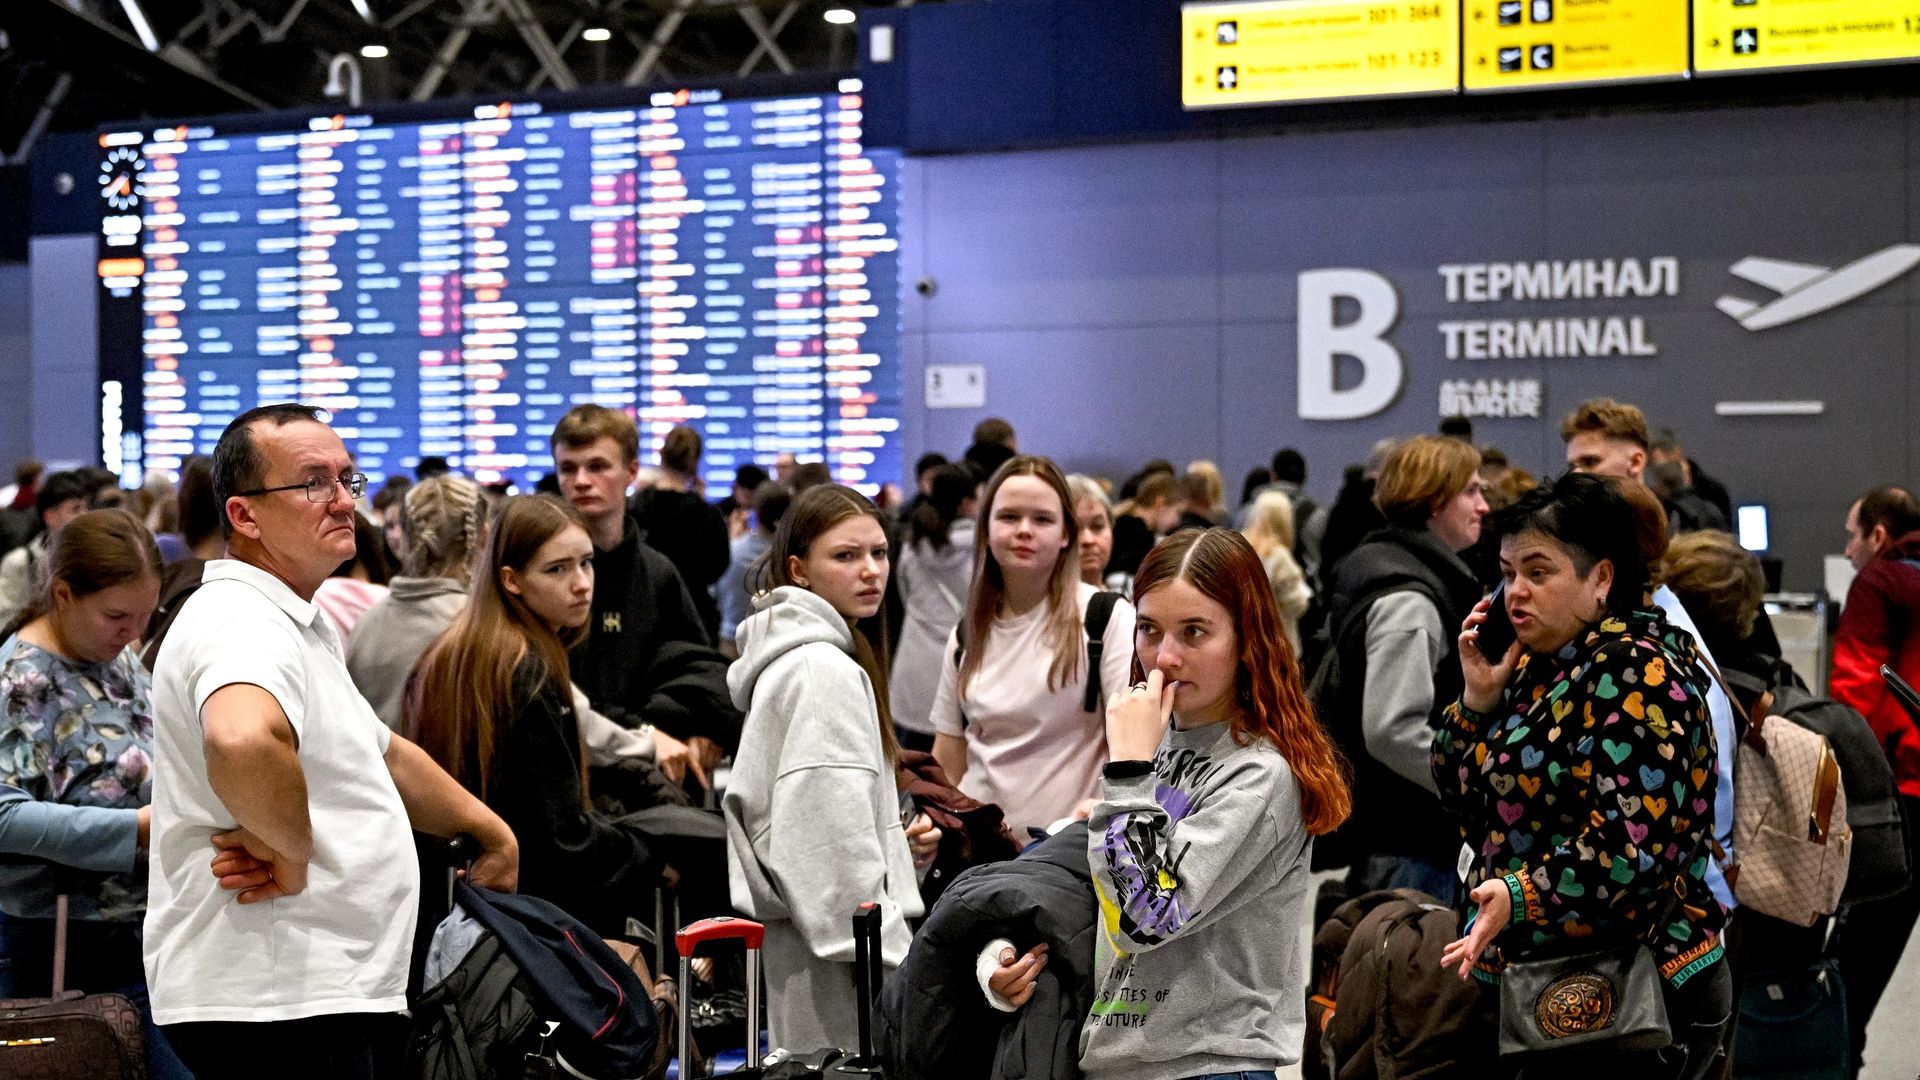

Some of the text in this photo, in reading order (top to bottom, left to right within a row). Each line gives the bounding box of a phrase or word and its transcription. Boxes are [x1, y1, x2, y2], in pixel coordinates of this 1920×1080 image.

[1438, 258, 1678, 301] ТЕРМИНАЛ
[1298, 268, 1402, 420] B
[1438, 317, 1656, 359] TERMINAL
[1154, 989, 1170, 1002] OF
